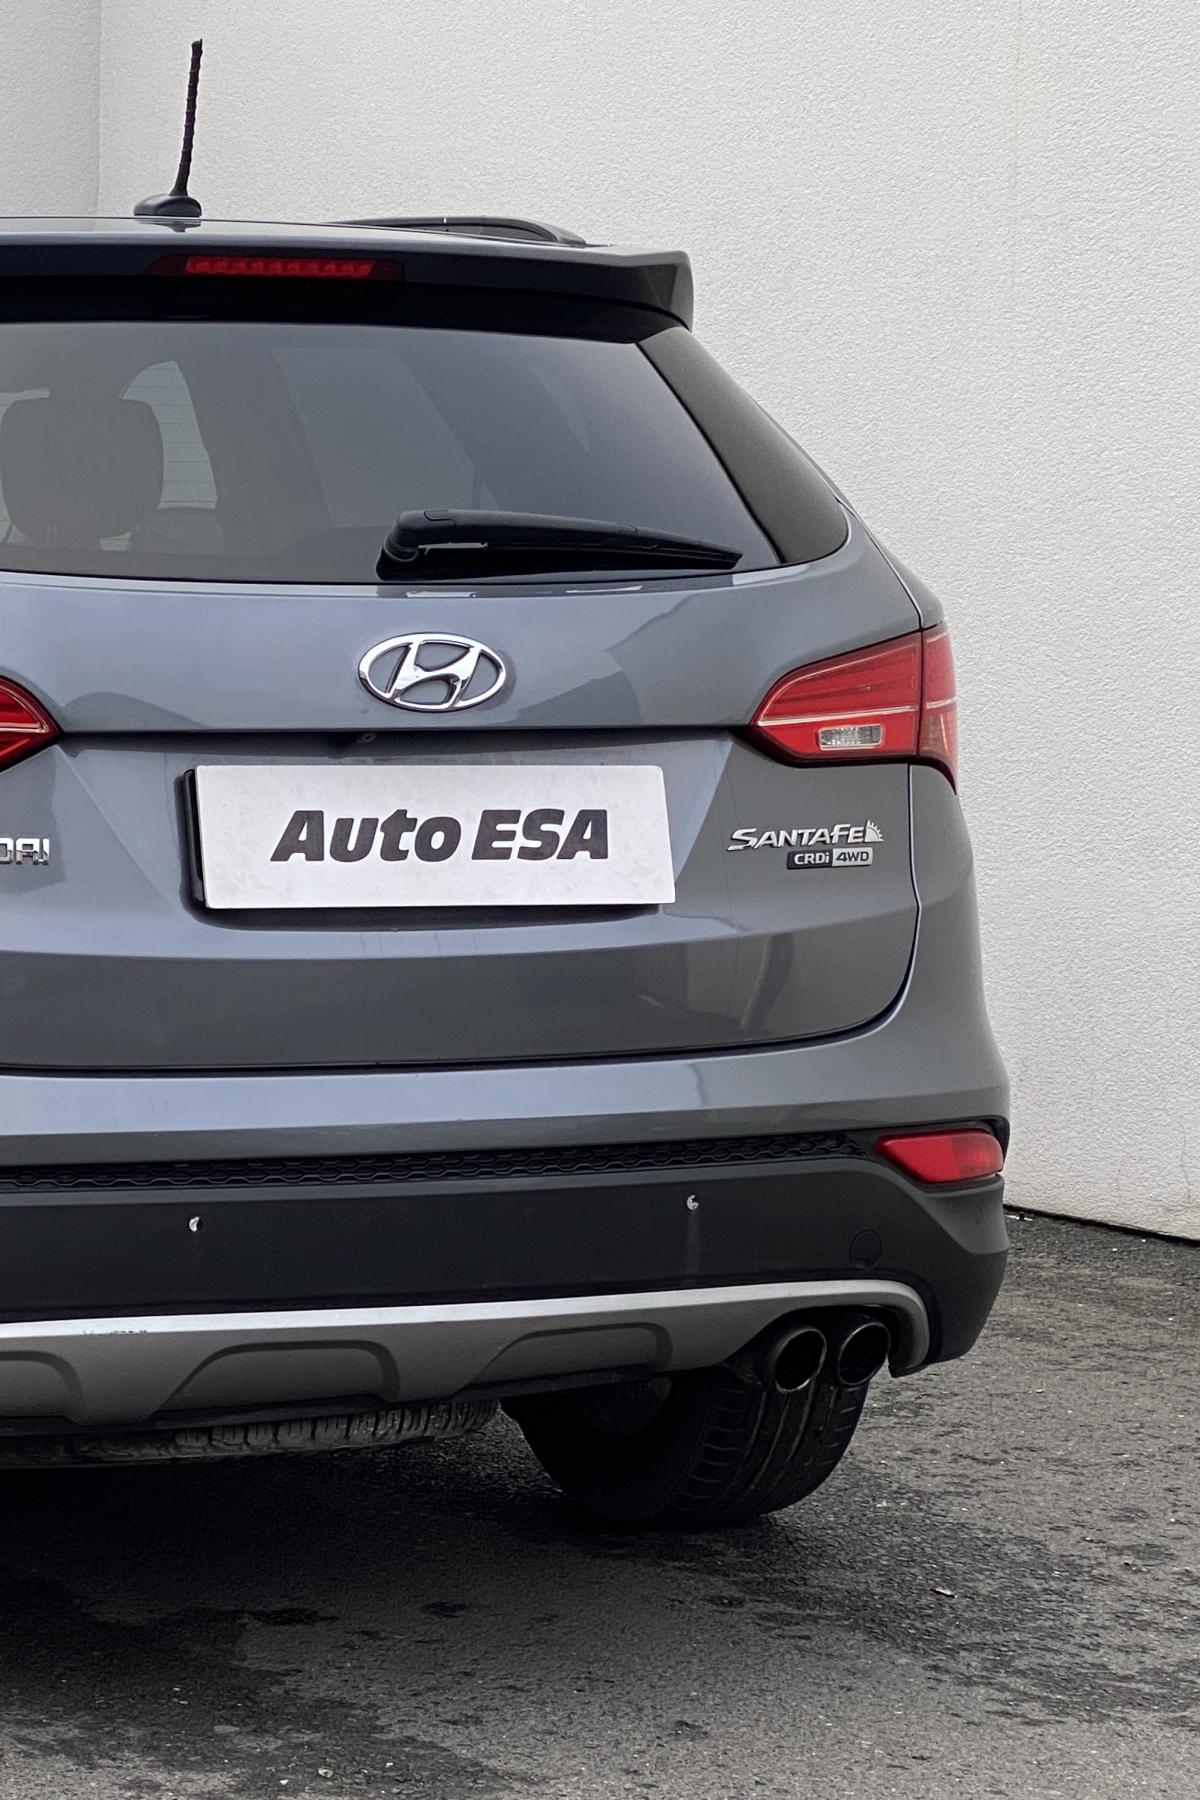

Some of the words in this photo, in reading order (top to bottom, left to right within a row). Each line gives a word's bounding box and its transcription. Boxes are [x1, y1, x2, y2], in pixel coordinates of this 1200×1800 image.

[270, 808, 462, 863] Auto
[471, 808, 609, 861] ESA
[793, 852, 830, 866] CRDi
[836, 851, 871, 863] 4WD
